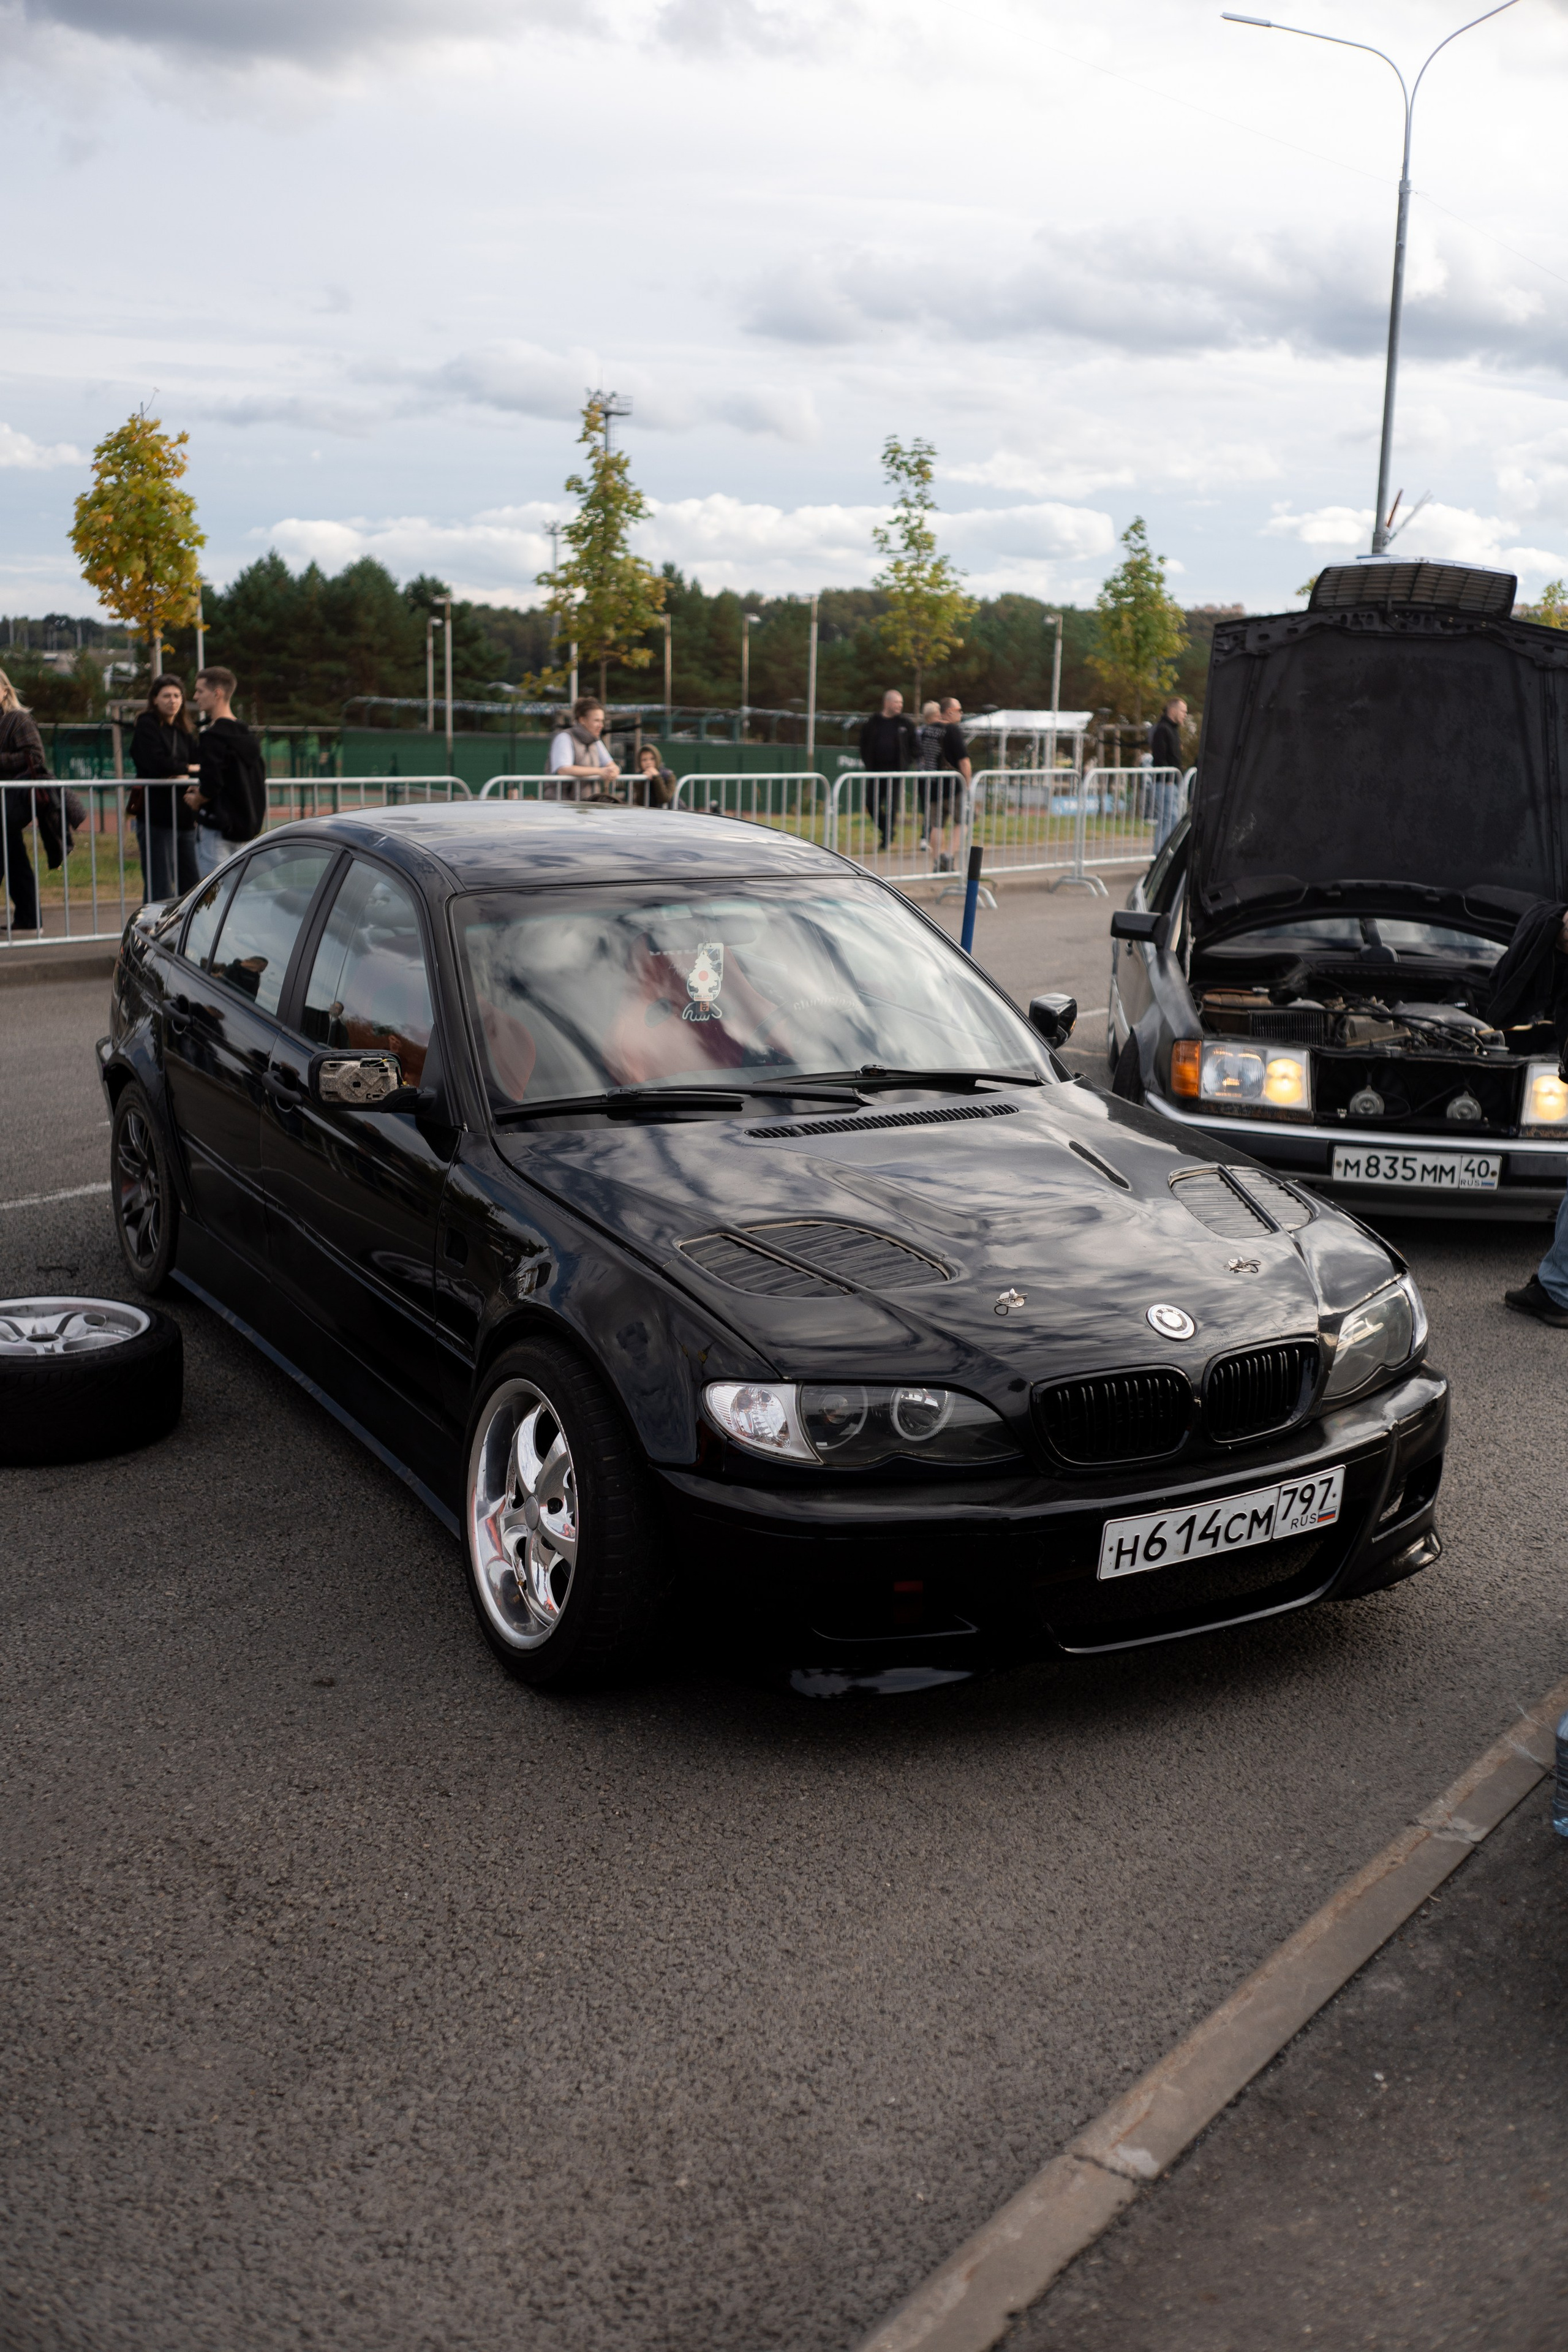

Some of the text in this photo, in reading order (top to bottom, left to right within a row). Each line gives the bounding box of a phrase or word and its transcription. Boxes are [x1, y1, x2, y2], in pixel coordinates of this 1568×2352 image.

[1343, 1155, 1490, 1184] М835ММ 40
[1114, 1476, 1334, 1570] Н614СМ 797
[1290, 1513, 1317, 1530] RUS
